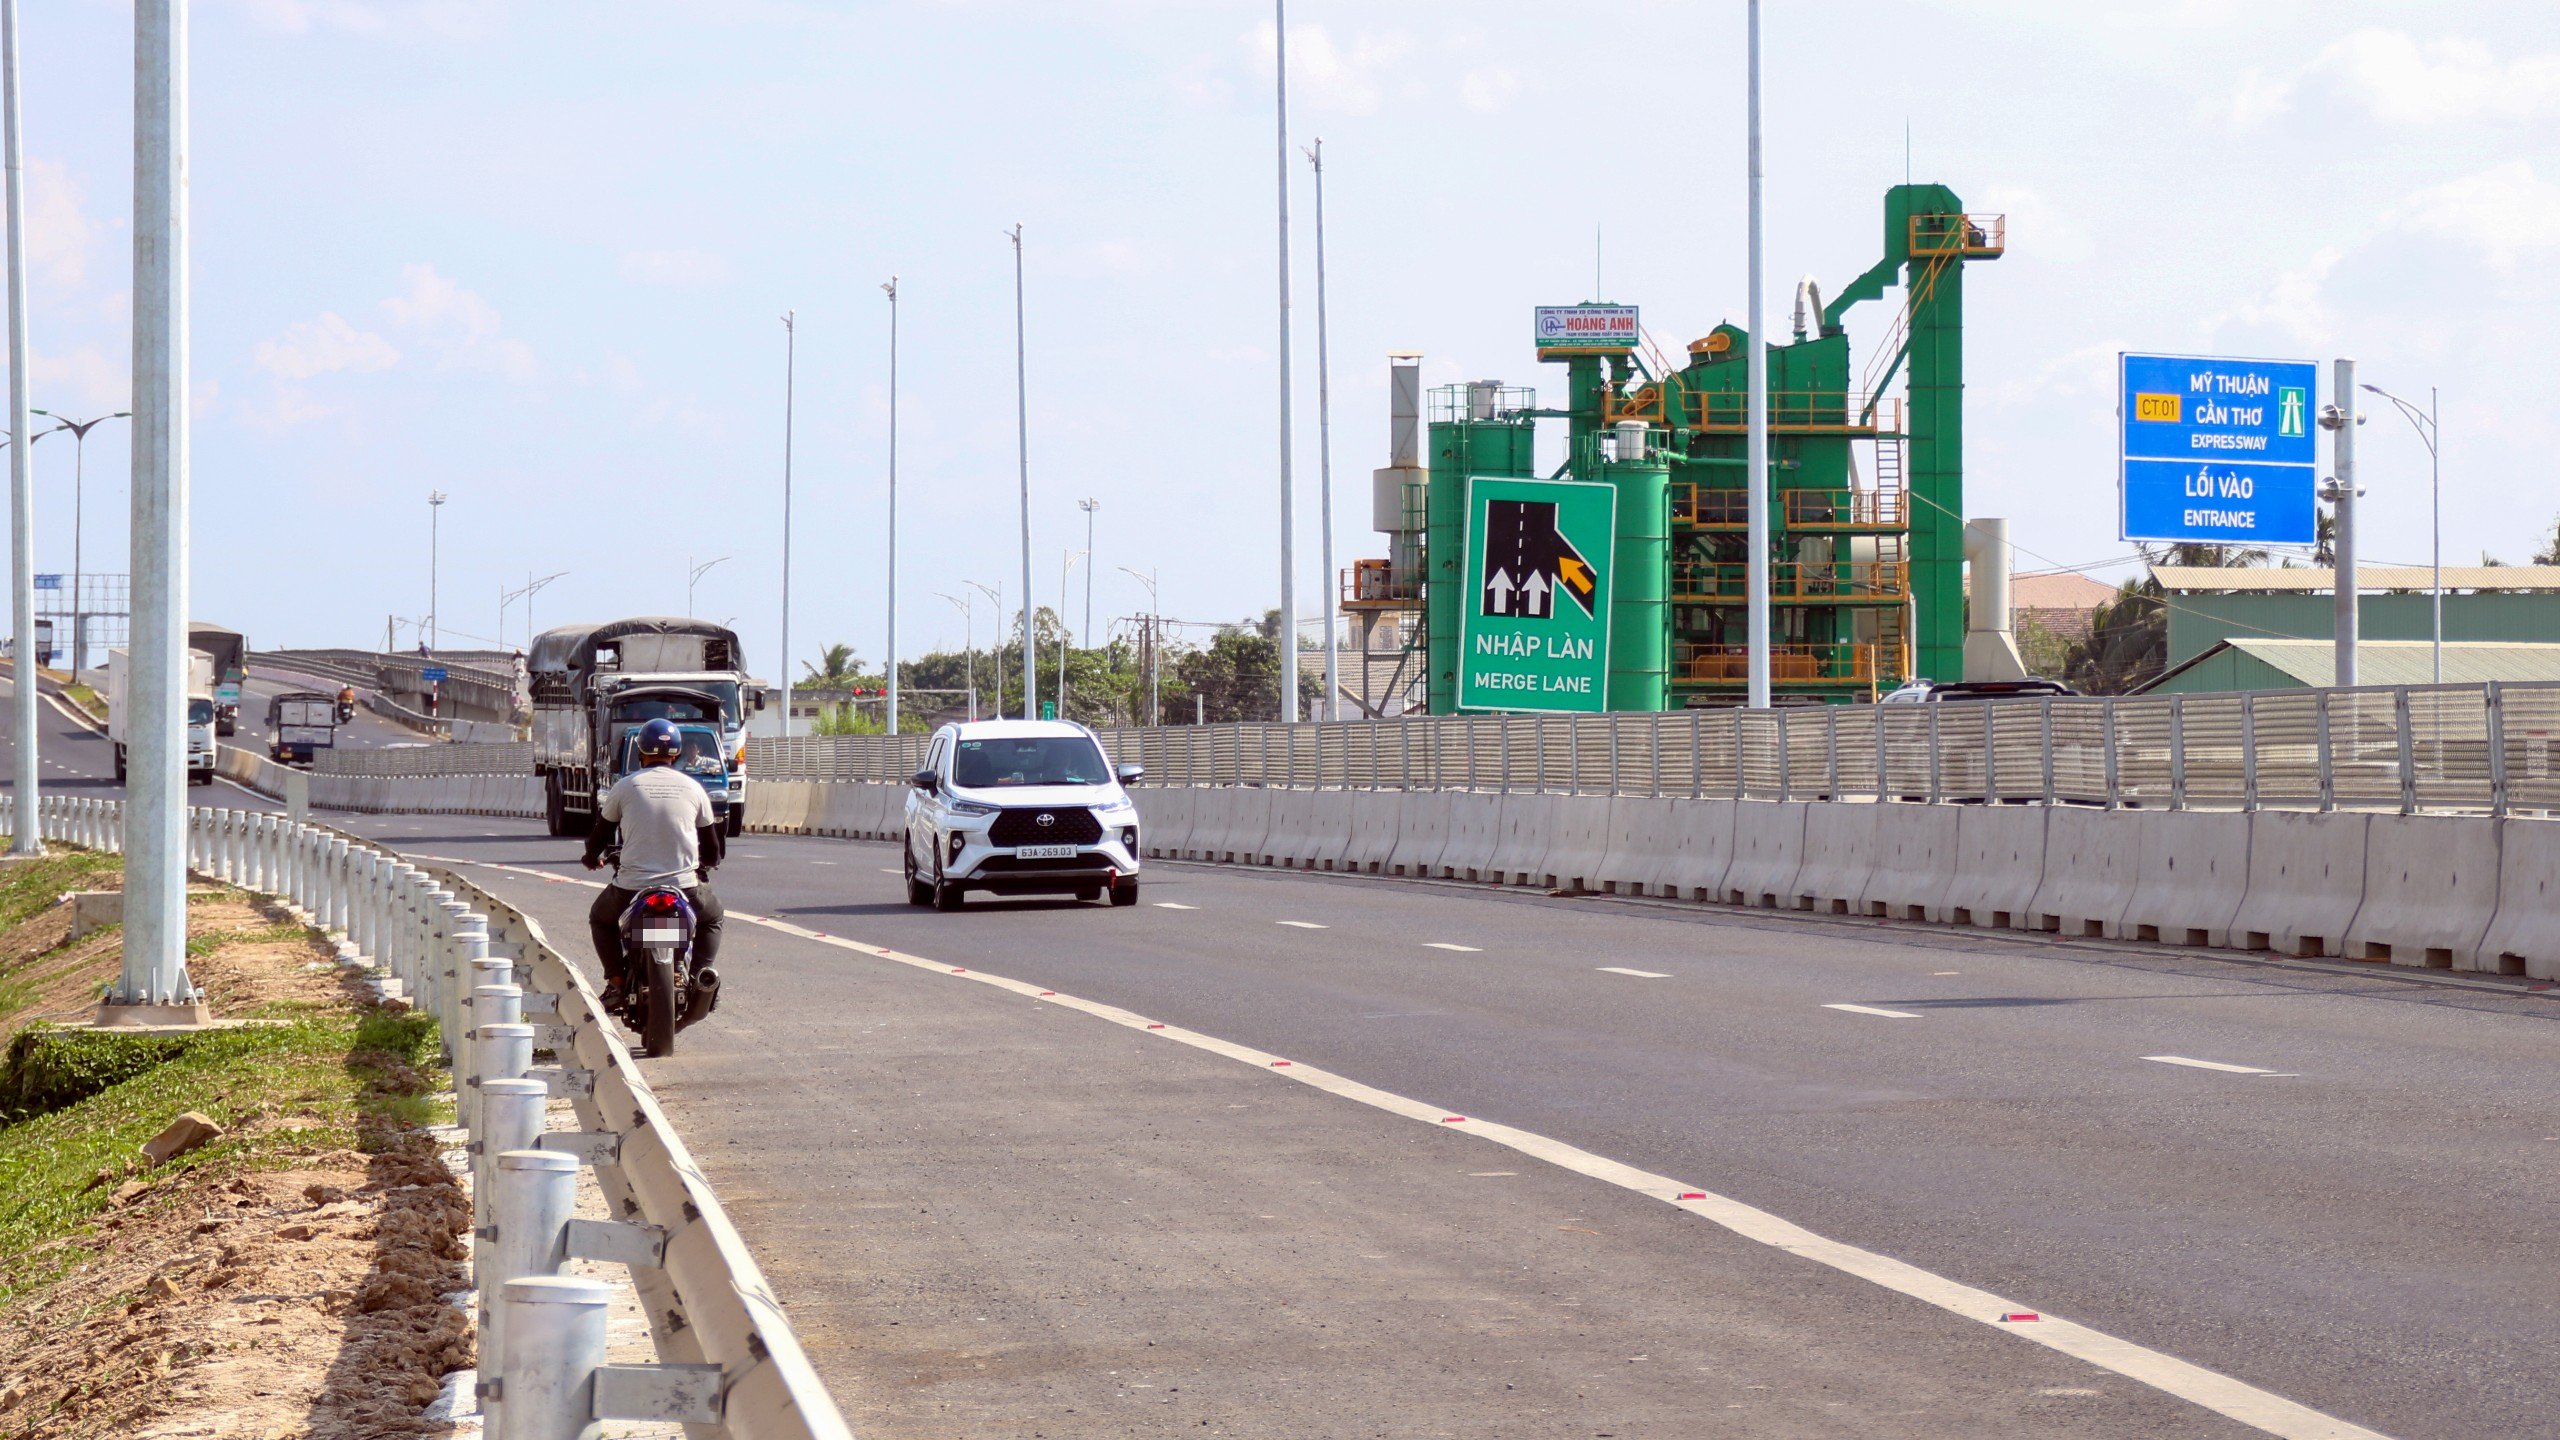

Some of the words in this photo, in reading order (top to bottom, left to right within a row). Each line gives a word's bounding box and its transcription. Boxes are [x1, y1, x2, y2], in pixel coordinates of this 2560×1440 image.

[1567, 315, 1606, 331] HOÀNG
[1610, 317, 1633, 331] ANH
[2190, 370, 2214, 393] MỸ
[2215, 373, 2269, 398] THUẬN
[2142, 398, 2175, 417] CT.01
[2195, 399, 2228, 425] CẦN
[2231, 407, 2263, 427] THƠ
[2191, 434, 2268, 450] EXPRESSWAY
[2185, 466, 2215, 498] LỐI
[2218, 471, 2254, 499] VÀO
[2184, 509, 2256, 529] ENTRANCE
[1476, 631, 1541, 661] NHẬP
[1547, 632, 1594, 660] LÀN
[1475, 672, 1538, 691] MERGE
[1543, 675, 1591, 693] LANE
[1021, 847, 1072, 857] 63A-269.03
